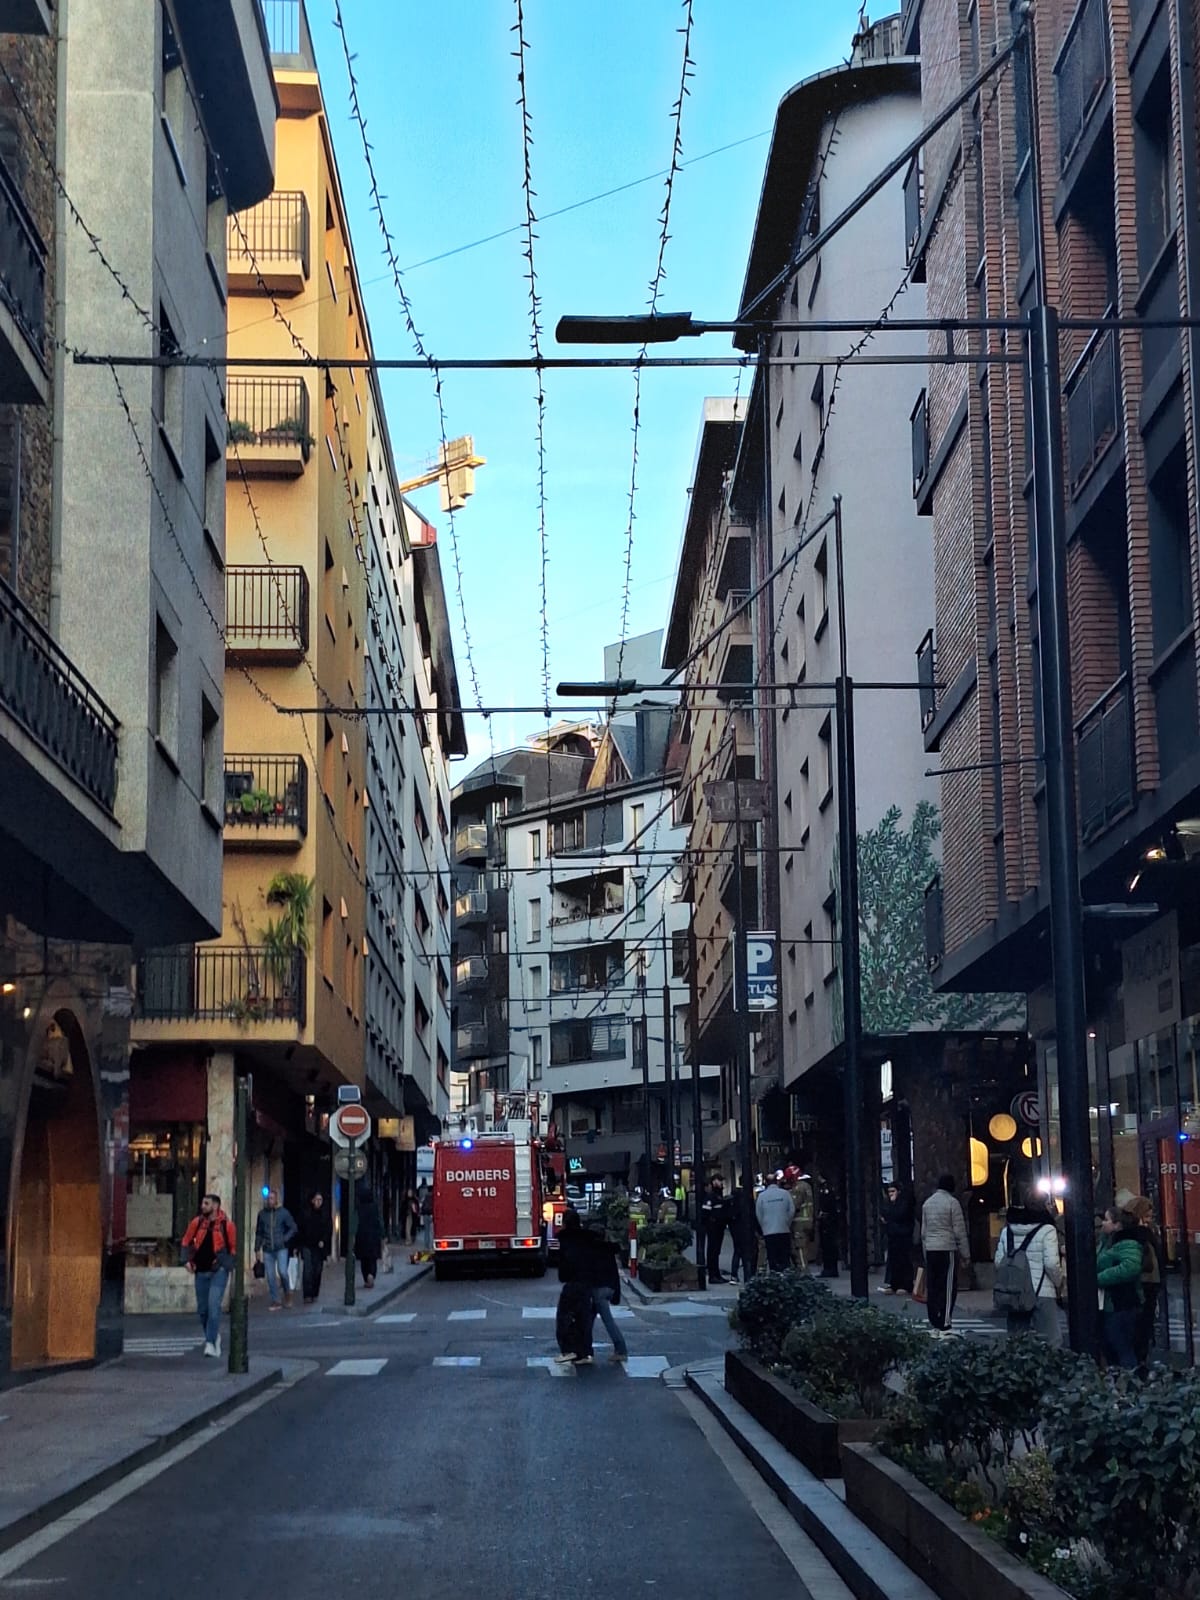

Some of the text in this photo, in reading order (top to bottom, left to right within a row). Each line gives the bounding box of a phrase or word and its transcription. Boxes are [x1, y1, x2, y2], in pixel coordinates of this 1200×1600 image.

[747, 942, 773, 974] P
[748, 984, 777, 994] TLAS
[446, 1169, 511, 1182] BOMBERS
[477, 1187, 497, 1197] 118
